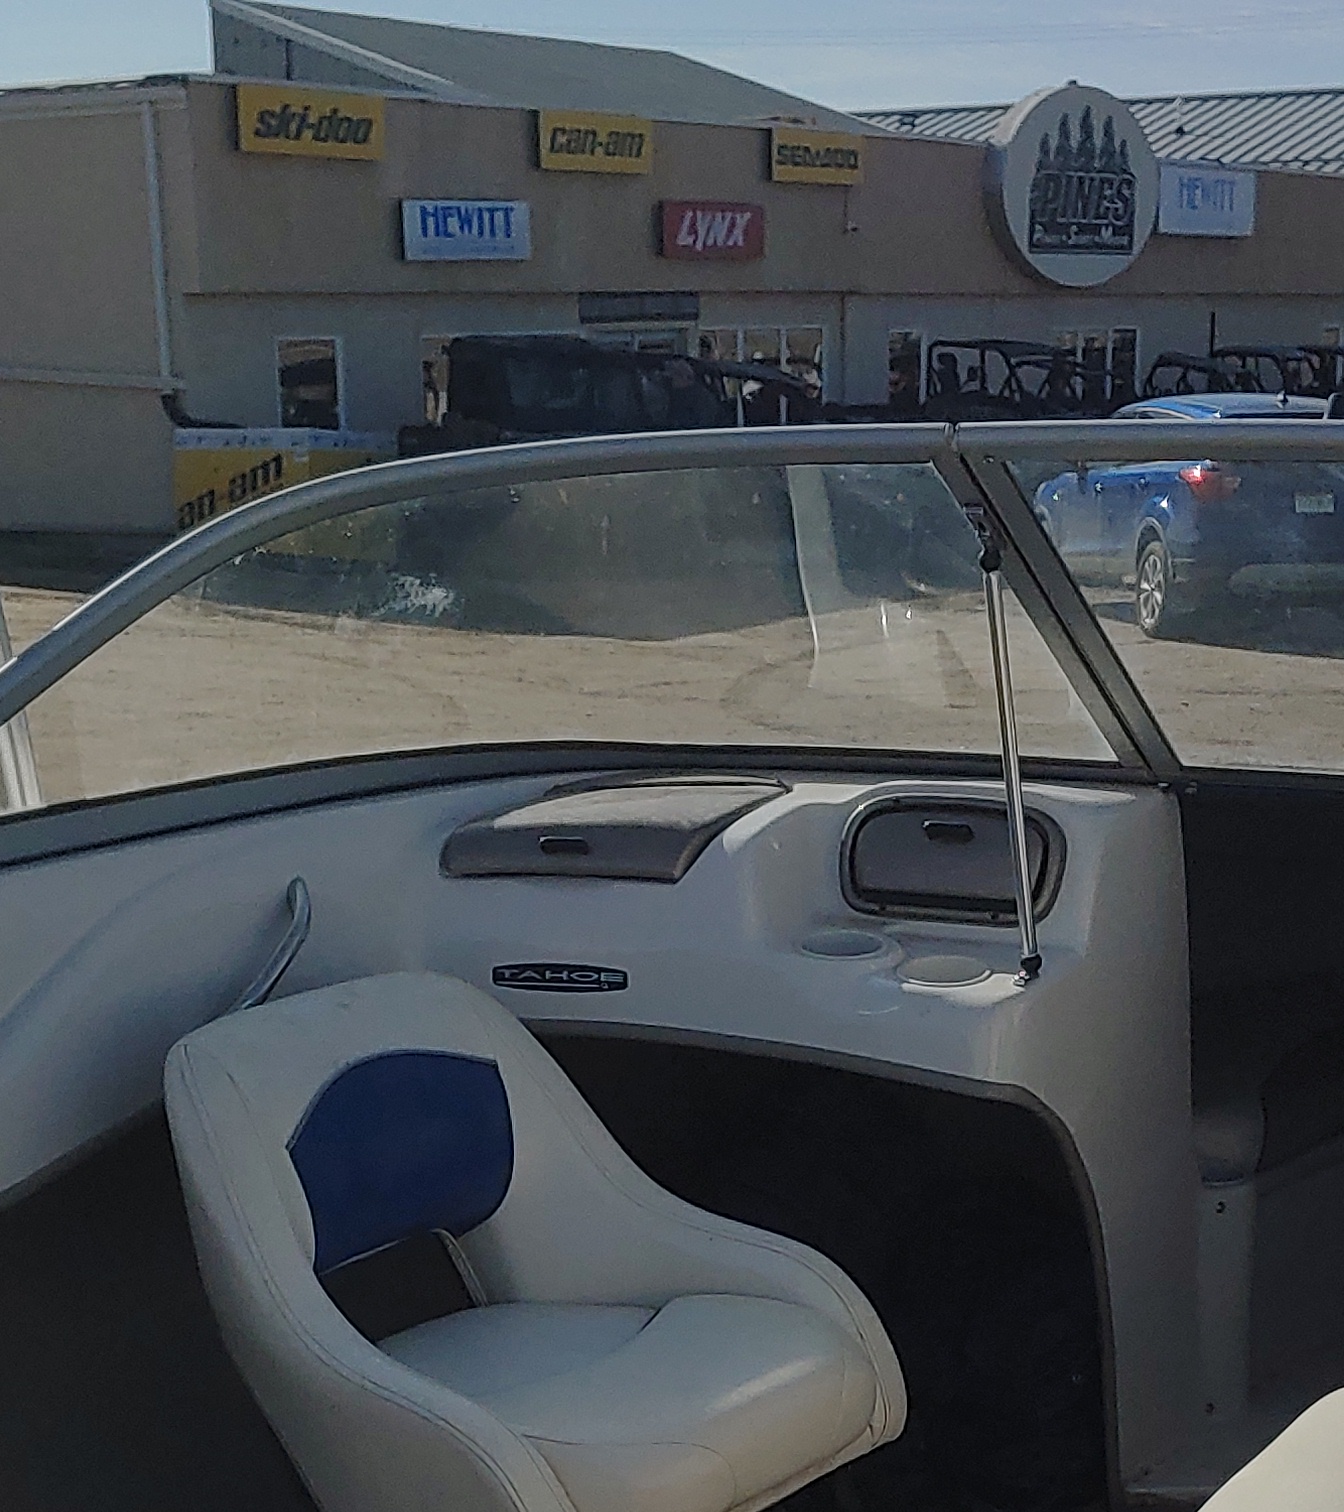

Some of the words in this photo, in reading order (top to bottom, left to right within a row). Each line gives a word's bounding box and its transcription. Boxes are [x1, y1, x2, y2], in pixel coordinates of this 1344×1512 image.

[419, 205, 515, 238] HEWITT
[676, 210, 752, 251] LYNX
[496, 968, 625, 983] TAHOE
